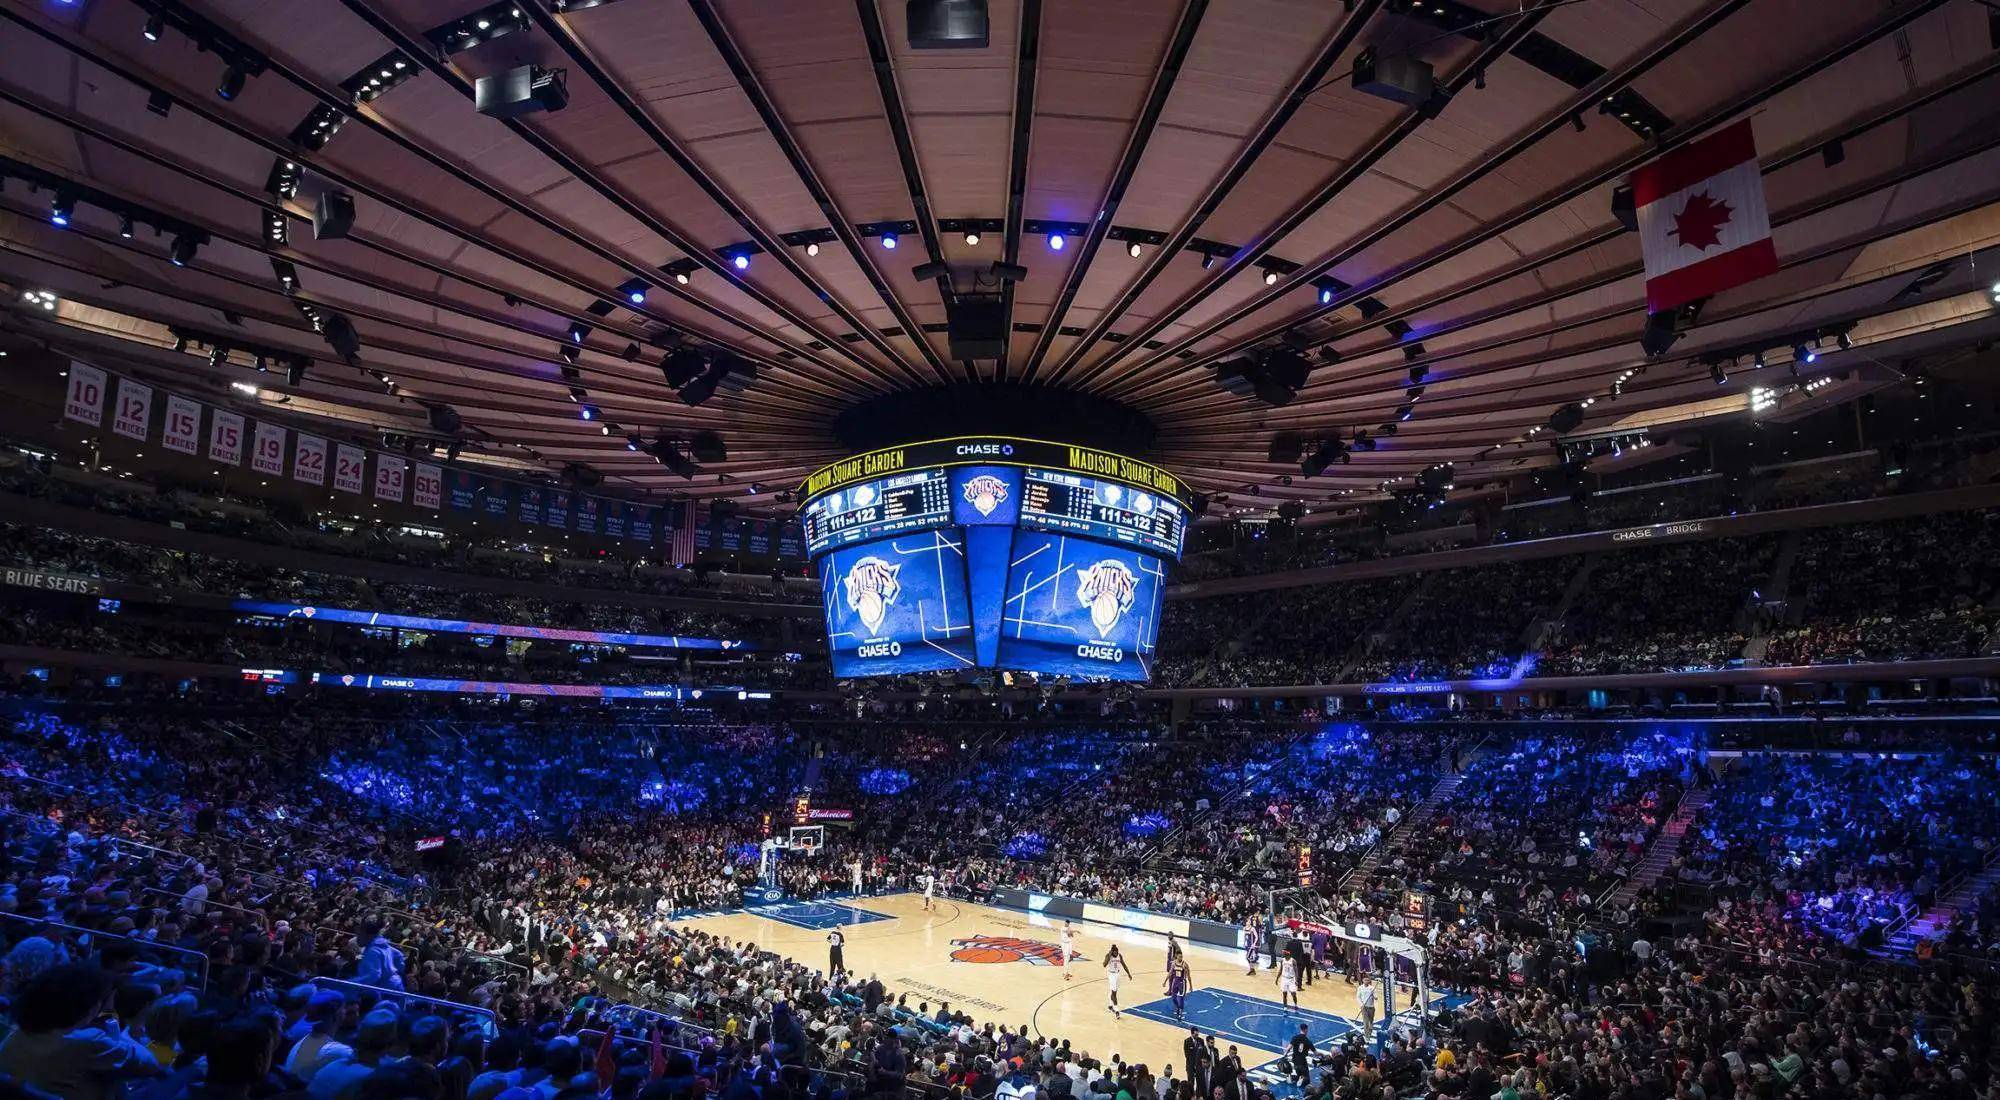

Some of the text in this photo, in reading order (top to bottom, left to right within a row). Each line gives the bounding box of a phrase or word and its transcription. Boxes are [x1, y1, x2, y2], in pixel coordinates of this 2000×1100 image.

[74, 381, 98, 406] 10
[67, 404, 99, 422] KNICKS
[121, 397, 144, 422] 12
[115, 419, 145, 437] KNICKS
[171, 412, 194, 436] 15
[165, 435, 195, 451] KNICKS
[216, 426, 238, 448] 15
[212, 447, 239, 462] KNICKS
[260, 438, 280, 459] 19
[956, 445, 1000, 455] CHASE
[254, 459, 281, 472] KNICKS
[298, 448, 323, 470] 22
[832, 458, 862, 484] SQUARE
[864, 450, 904, 475] GARDEN
[296, 468, 323, 482] KNICKS
[339, 458, 360, 479] 24
[379, 468, 401, 487] 33
[1069, 447, 1177, 496] MADISON SQUARE GARDEN
[336, 478, 360, 491] KNICKS
[377, 487, 401, 499] KNICKS
[416, 476, 440, 495] 613
[416, 495, 438, 505] KNICKS
[830, 514, 845, 530] 111
[855, 507, 876, 523] 122
[1100, 507, 1121, 523] 111
[1133, 515, 1151, 531] 122
[1612, 523, 1704, 541] CHASE BRIDGE
[6, 571, 88, 593] BLUE SEATS
[858, 643, 890, 657] CHASE
[1077, 644, 1113, 661] CHASE
[809, 808, 849, 819] Budweiser
